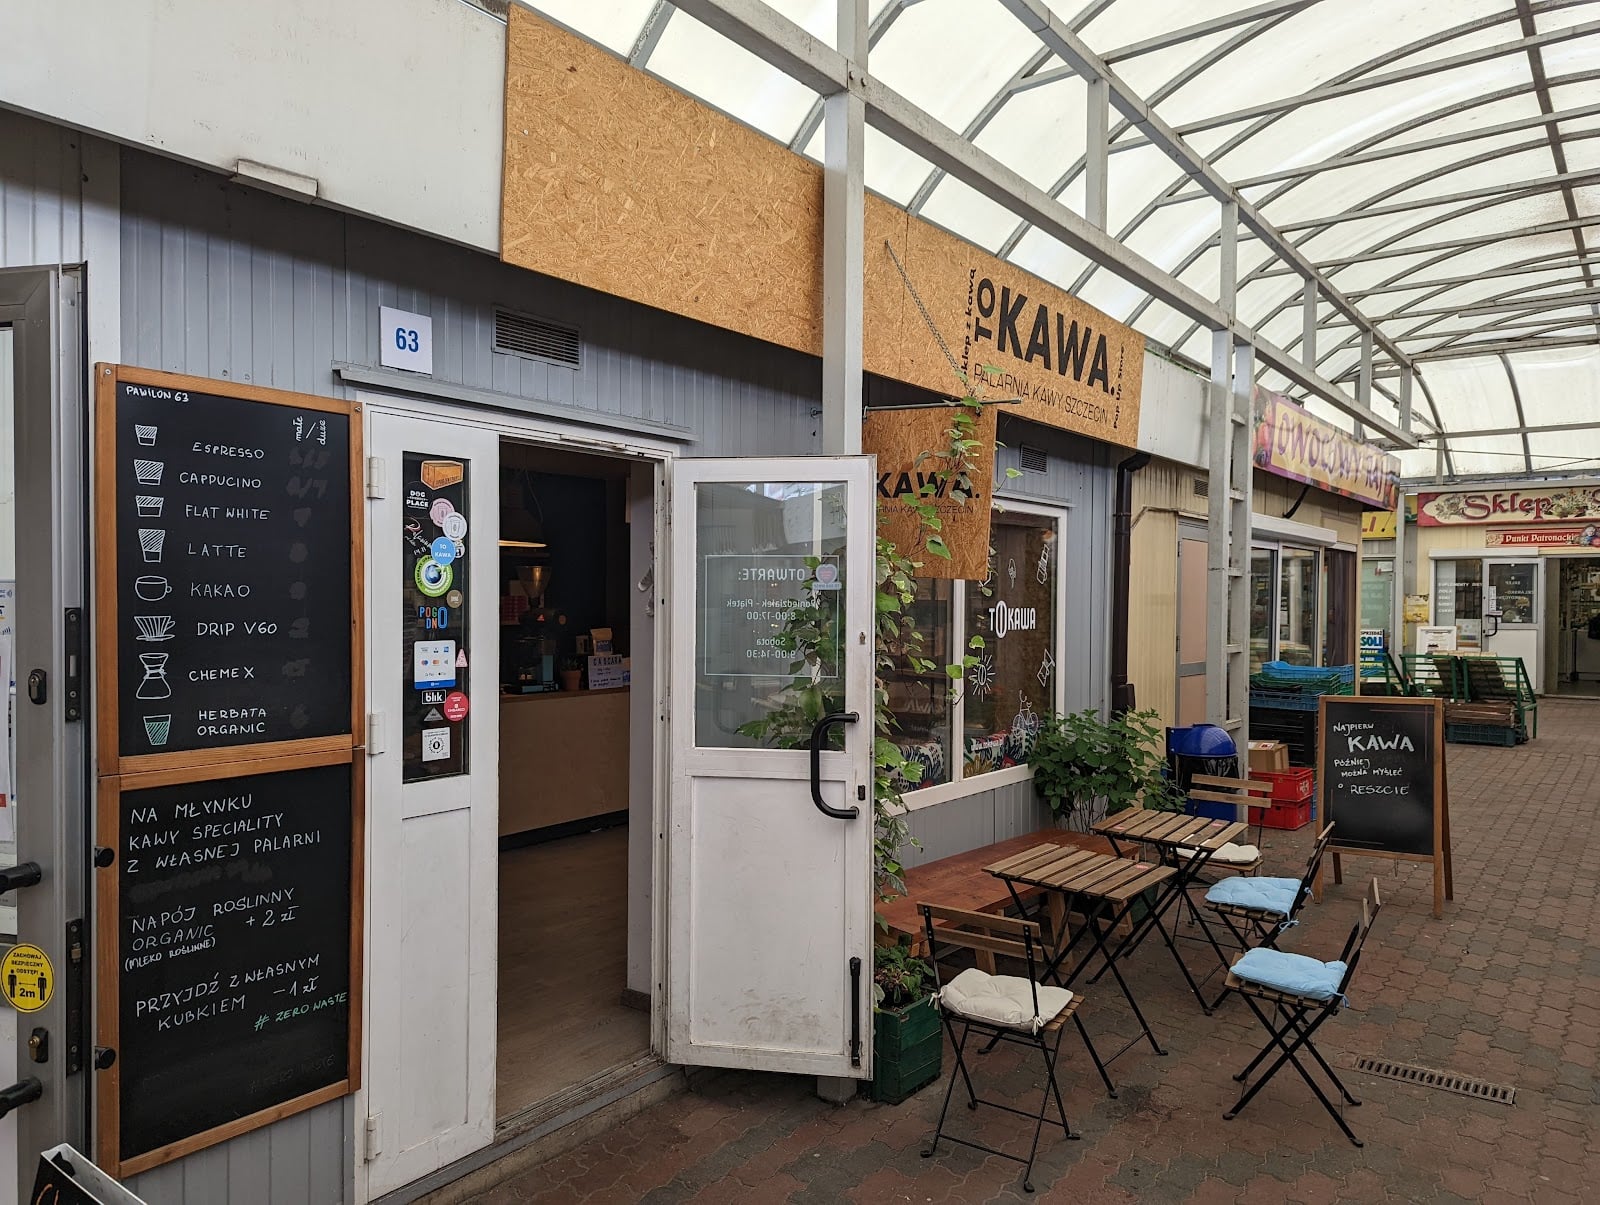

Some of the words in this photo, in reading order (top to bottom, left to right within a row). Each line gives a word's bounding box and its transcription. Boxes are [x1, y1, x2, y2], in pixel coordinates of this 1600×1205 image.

[395, 327, 419, 352] 63
[974, 278, 996, 342] TO
[997, 285, 1116, 396] KAWA.
[126, 385, 172, 400] PAWILON
[174, 392, 189, 402] 63
[974, 363, 1030, 399] PALARNIA
[1032, 384, 1063, 407] KAWY
[1064, 395, 1108, 424] SZCZECIN
[193, 442, 265, 459] ESPRESSO
[179, 472, 262, 489] CAPPUCINO
[410, 490, 426, 498] DOG
[406, 499, 429, 508] PLACE
[936, 505, 974, 514] ZCZECIN
[1460, 492, 1551, 521] Sklep
[185, 504, 220, 519] FLAT
[225, 507, 270, 521] WHITE
[1505, 534, 1529, 543] Punkt
[1531, 533, 1575, 543] Patronacki
[187, 543, 247, 559] LATTE
[190, 582, 251, 598] KAKAO
[988, 600, 1036, 639] TOKAWA
[196, 622, 235, 637] DRIP
[244, 621, 278, 635] V60
[1360, 636, 1383, 647] SOLI
[188, 666, 255, 682] CHEMEX
[425, 691, 443, 702] blik
[198, 707, 267, 722] HERBATA
[196, 722, 266, 737] ORGANIC
[1333, 722, 1375, 736] NAJPIERW
[1347, 734, 1415, 753] KAWA
[1341, 769, 1368, 778] MOŻNA
[1372, 767, 1403, 777] MYŚLEĆ
[1350, 784, 1409, 796] RESZCIE
[130, 807, 158, 825] NA
[174, 793, 253, 819] MŁYNKU
[129, 830, 180, 851] KAWY
[191, 812, 284, 841] SPECIALITY
[127, 859, 139, 873] Z
[155, 842, 240, 869] WŁASNEJ
[254, 830, 321, 853] PALARNI
[131, 904, 197, 934] NAPÓJ
[262, 909, 276, 928] 2
[131, 924, 215, 952] ORGANIC
[11, 960, 43, 968] BEZPIECZNY
[13, 952, 42, 960] ZACHOWAJ
[124, 951, 163, 973] (MLEKO
[19, 987, 36, 998] 2m
[136, 972, 221, 1017] PRZYJDŹ
[229, 974, 240, 989] Z
[245, 953, 320, 984] WŁASNYM
[157, 995, 246, 1032] KUBKIEM
[276, 1003, 310, 1022] ZERO
[313, 992, 348, 1011] WASTE
